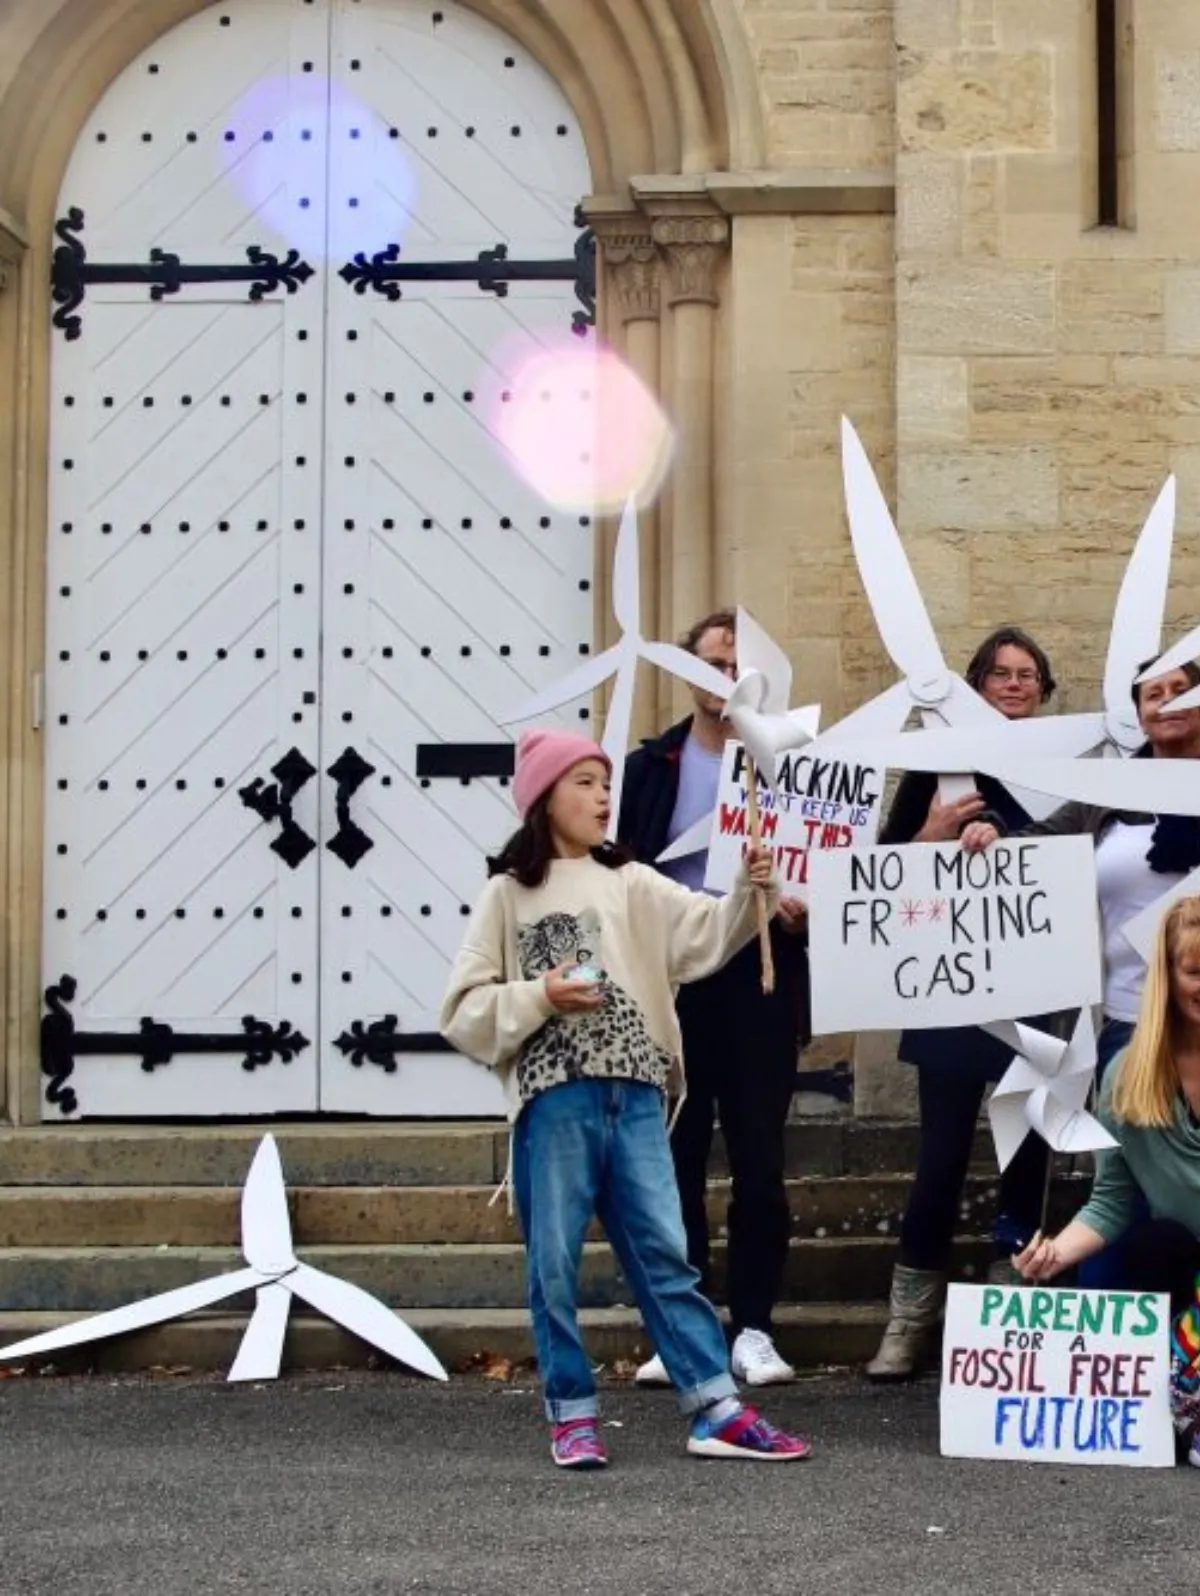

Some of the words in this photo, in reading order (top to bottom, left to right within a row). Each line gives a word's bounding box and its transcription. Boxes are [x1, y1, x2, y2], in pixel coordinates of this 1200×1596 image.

[801, 799, 842, 821] KEEP
[849, 806, 869, 827] US
[803, 819, 853, 850] THIS
[850, 851, 904, 892] NO
[933, 844, 1040, 891] MORE
[894, 947, 995, 999] GAS!
[979, 1288, 1160, 1337] PARENTS
[1004, 1330, 1044, 1351] FOR
[1069, 1334, 1087, 1352] A
[949, 1347, 1045, 1393] FOSSIL
[1068, 1354, 1154, 1398] FREE
[994, 1397, 1142, 1452] FUTURE
